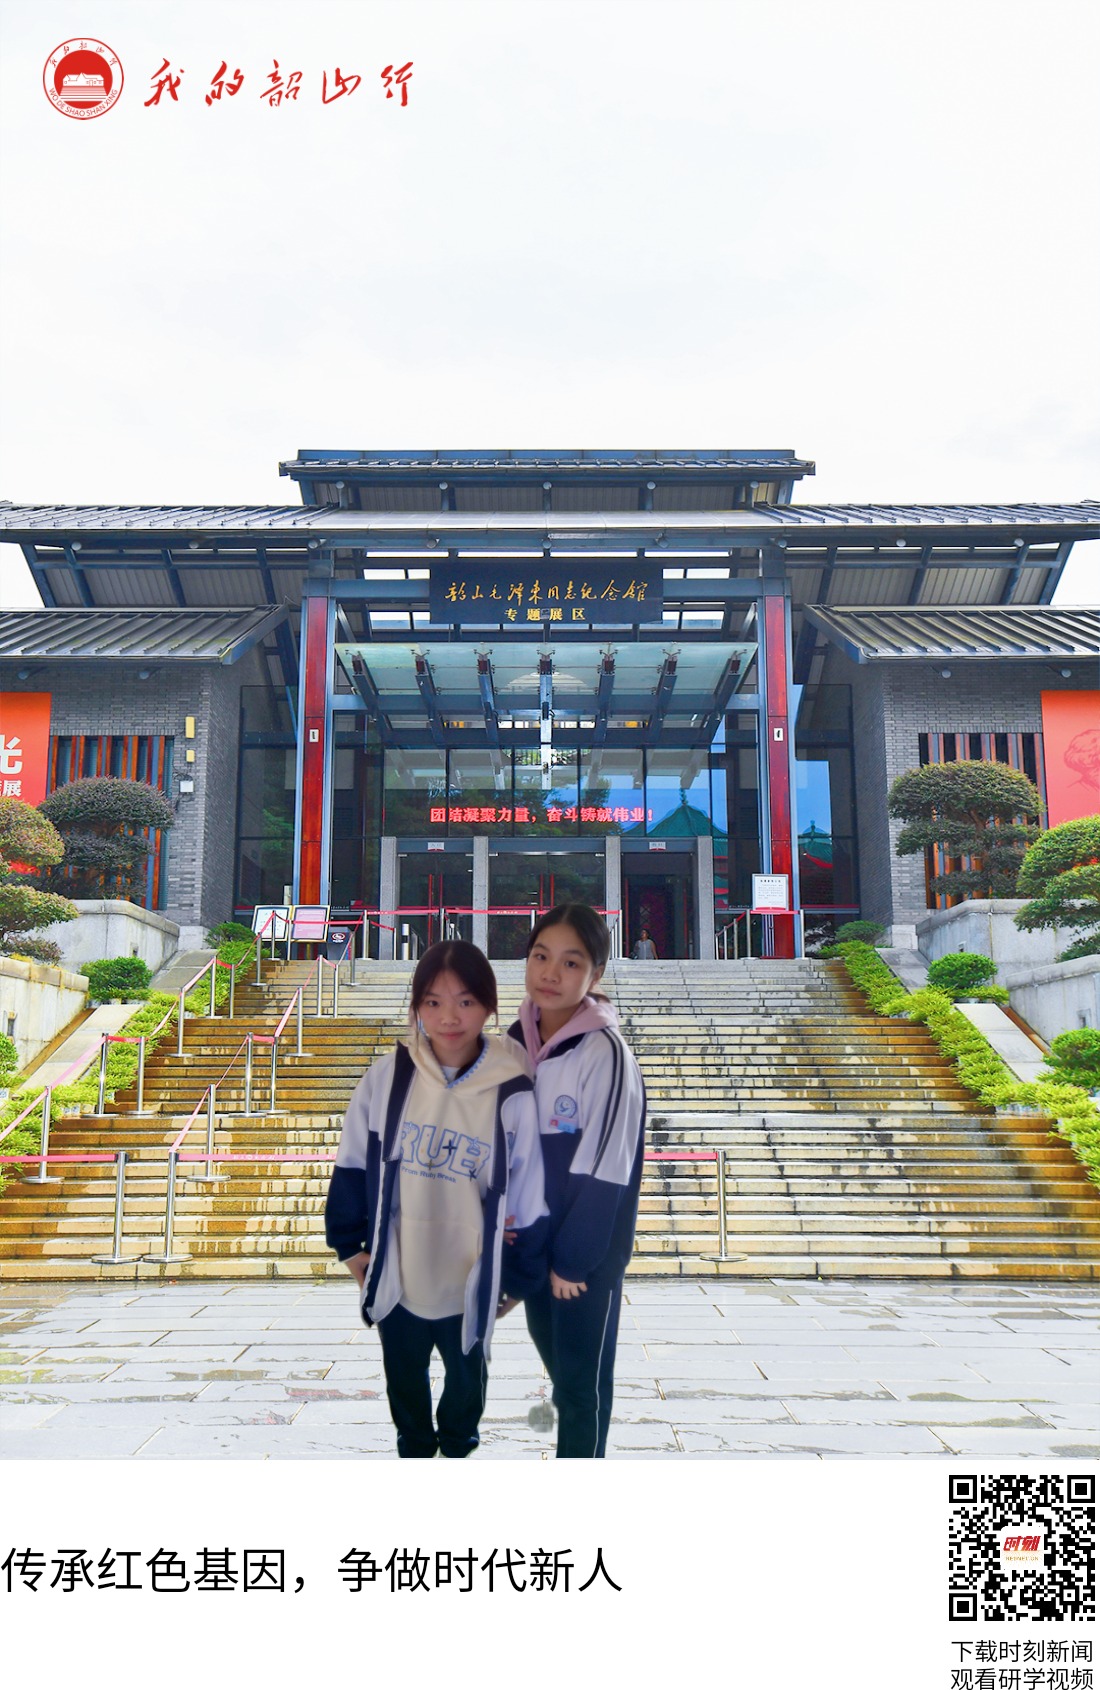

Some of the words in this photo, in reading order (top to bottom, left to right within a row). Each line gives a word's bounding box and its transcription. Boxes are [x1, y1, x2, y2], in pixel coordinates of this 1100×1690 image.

[504, 607, 586, 622] 专题展区
[0, 779, 22, 797] 展
